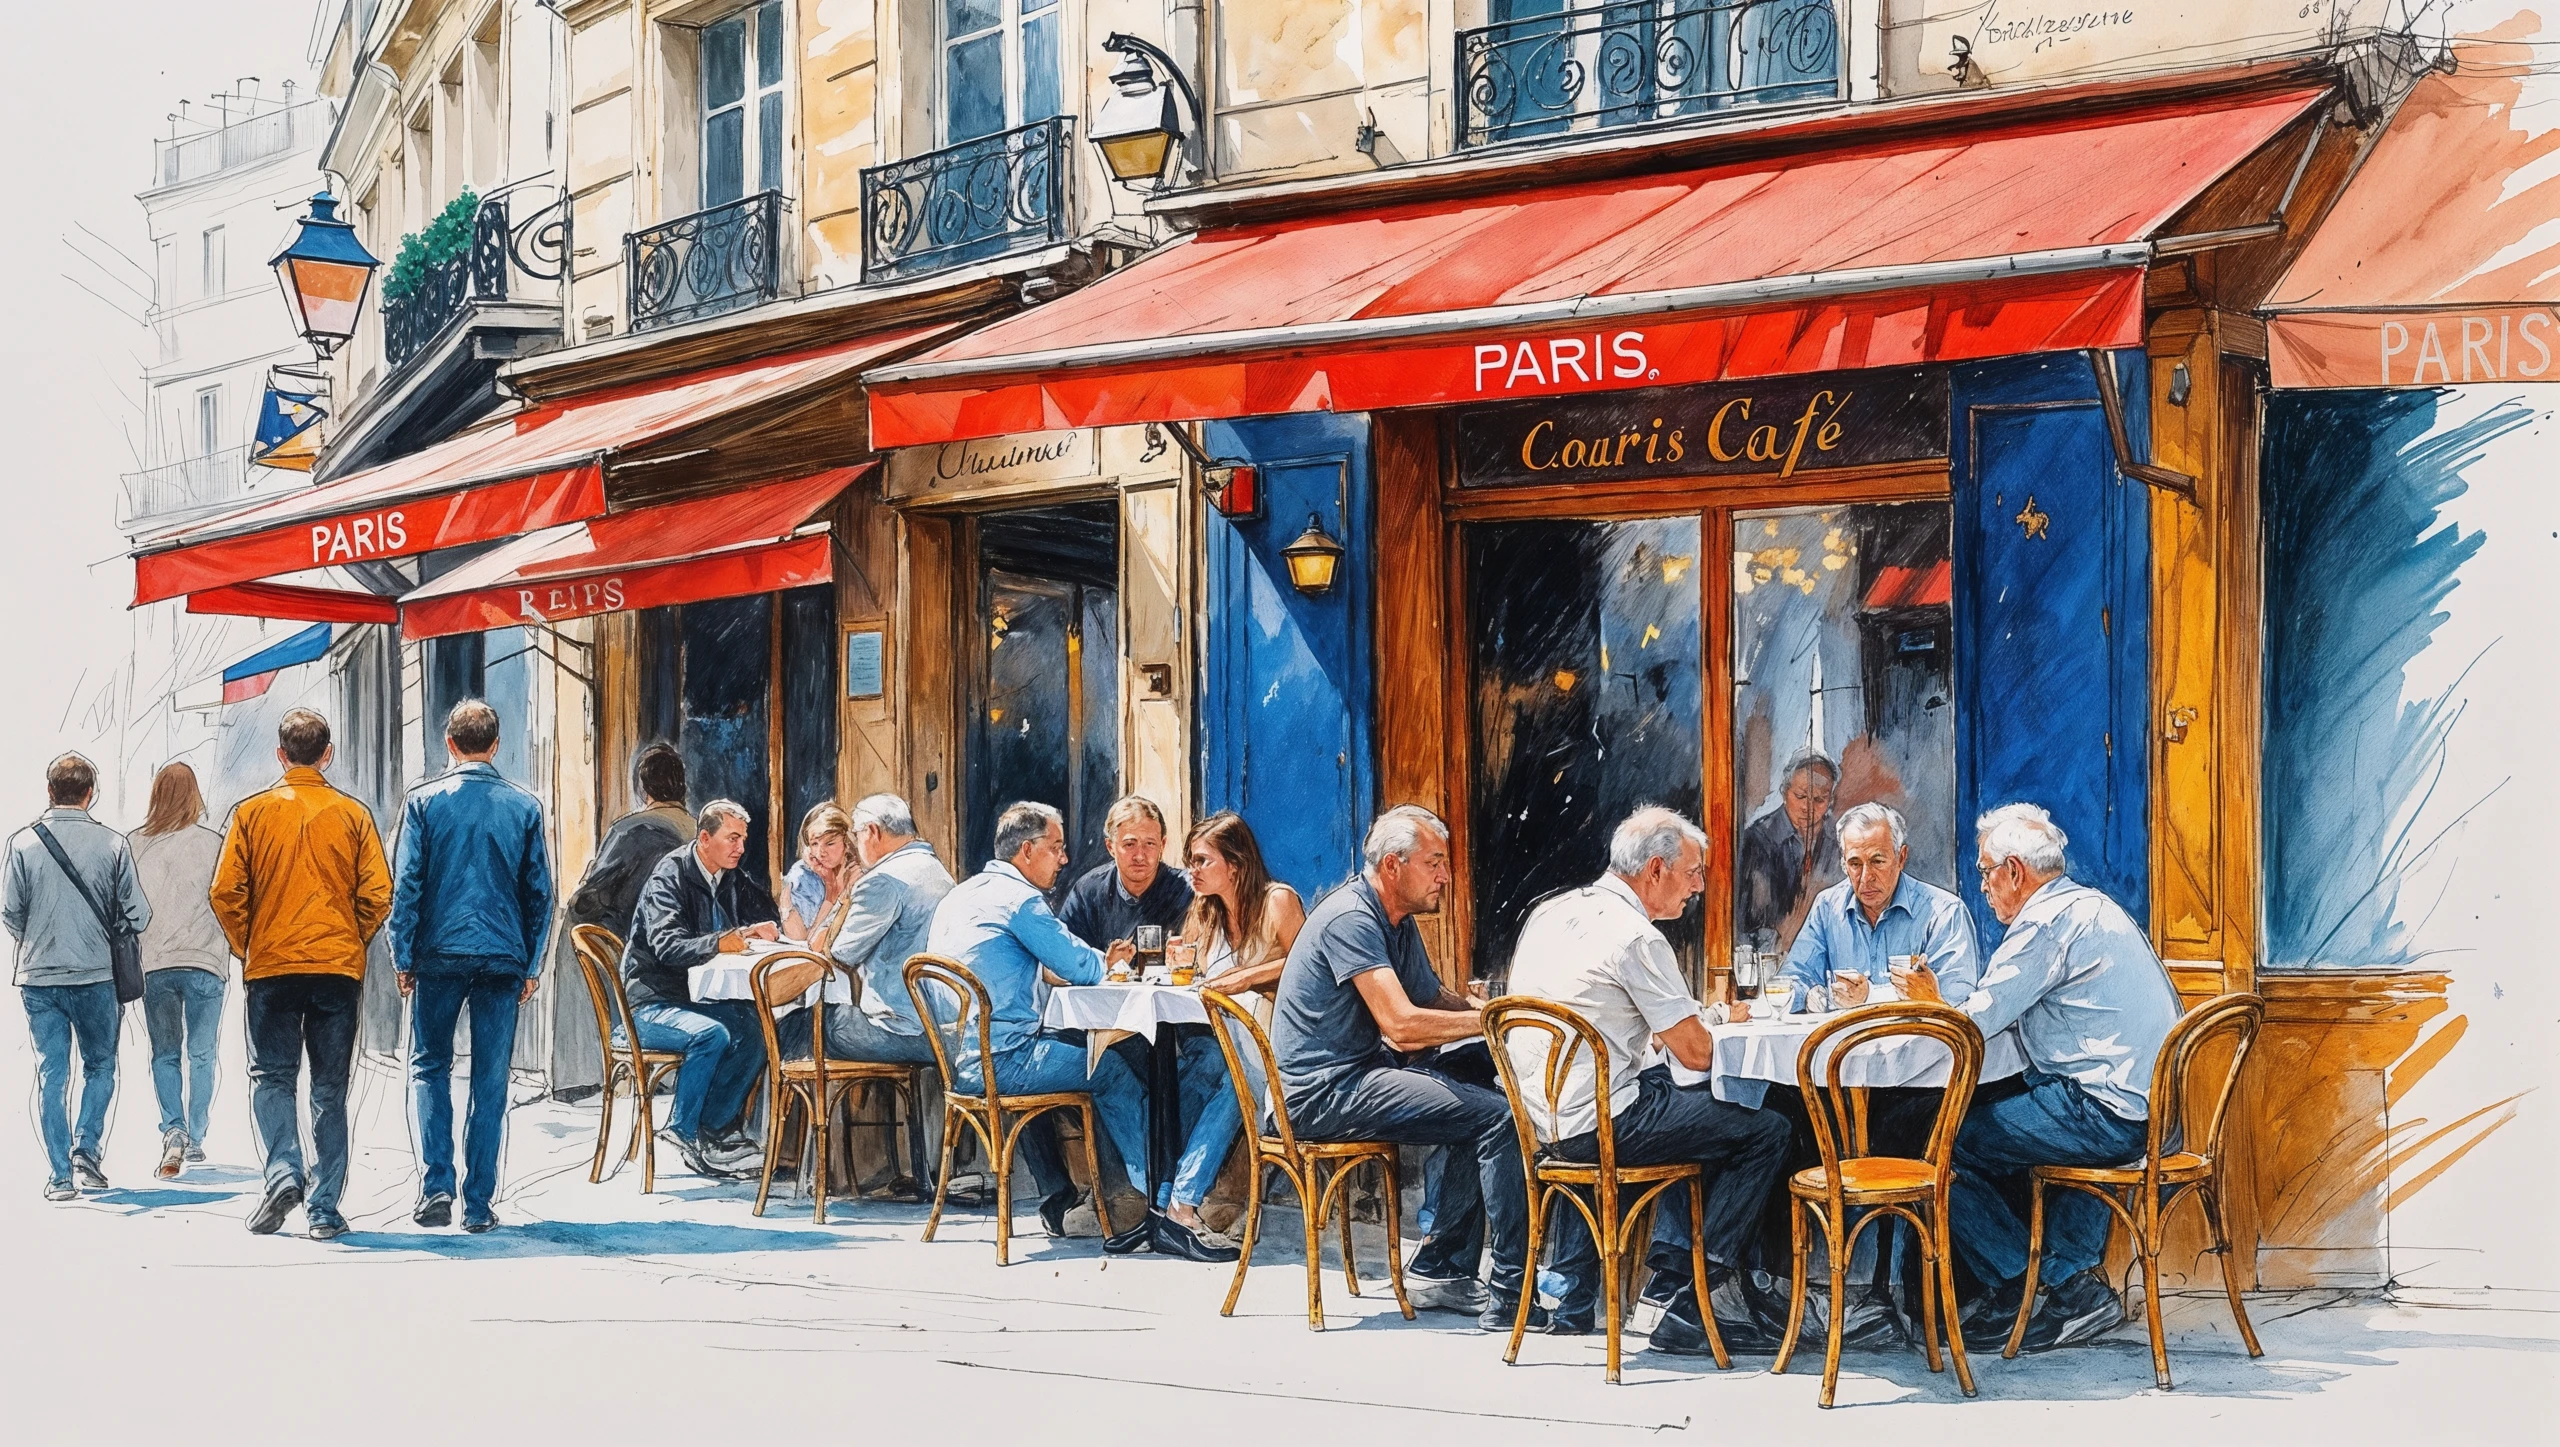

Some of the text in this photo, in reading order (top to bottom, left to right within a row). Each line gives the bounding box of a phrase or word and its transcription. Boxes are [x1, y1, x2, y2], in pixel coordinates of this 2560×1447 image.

[2381, 312, 2551, 386] PARIS
[1707, 390, 1853, 478] Café
[312, 511, 407, 563] PARIS
